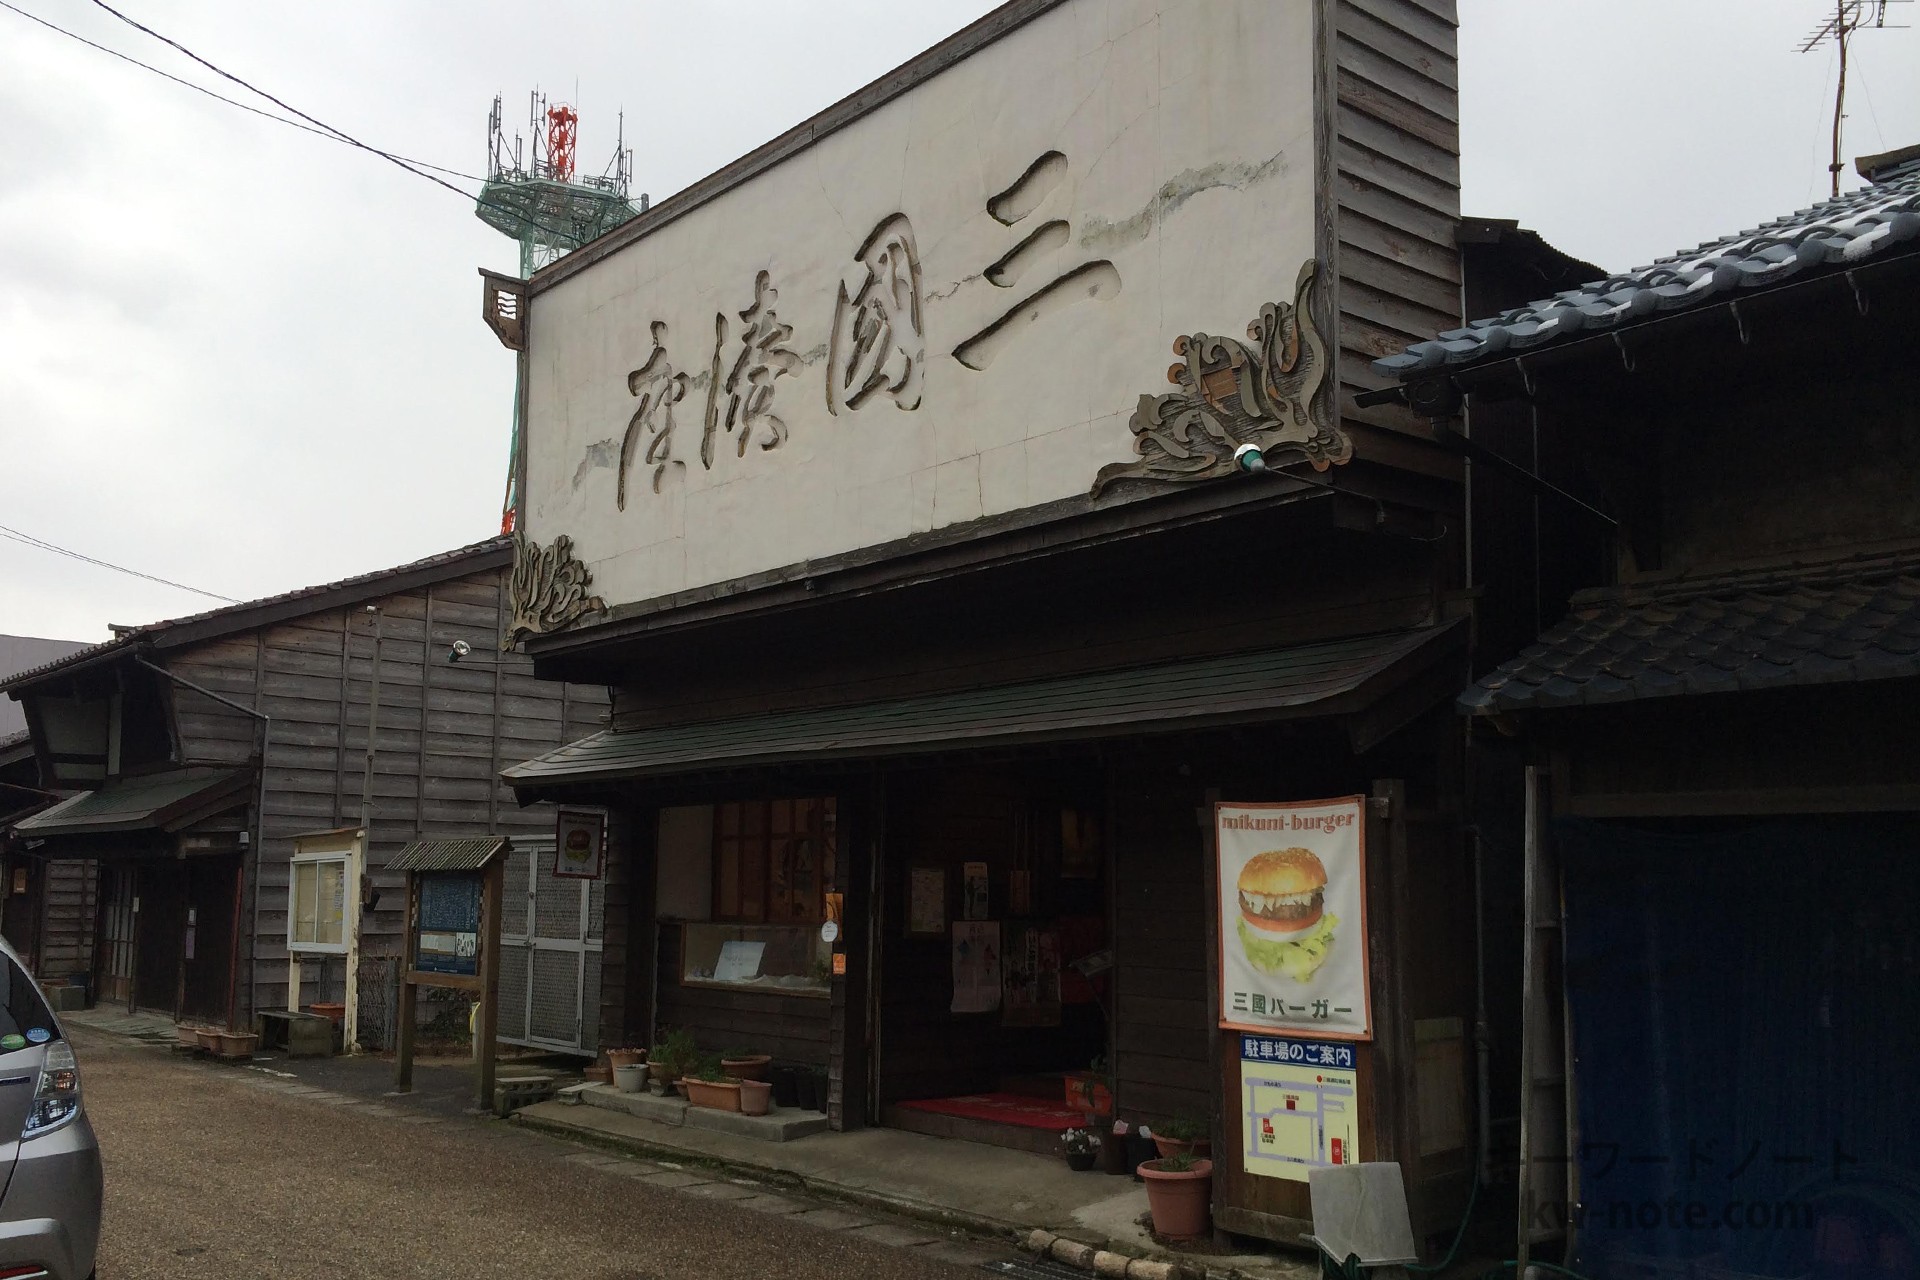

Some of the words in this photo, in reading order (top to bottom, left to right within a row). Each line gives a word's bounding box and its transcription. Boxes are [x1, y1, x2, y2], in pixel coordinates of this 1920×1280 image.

[1222, 813, 1355, 834] mikuni-burger
[1244, 1038, 1351, 1067] 駐車場のご案内
